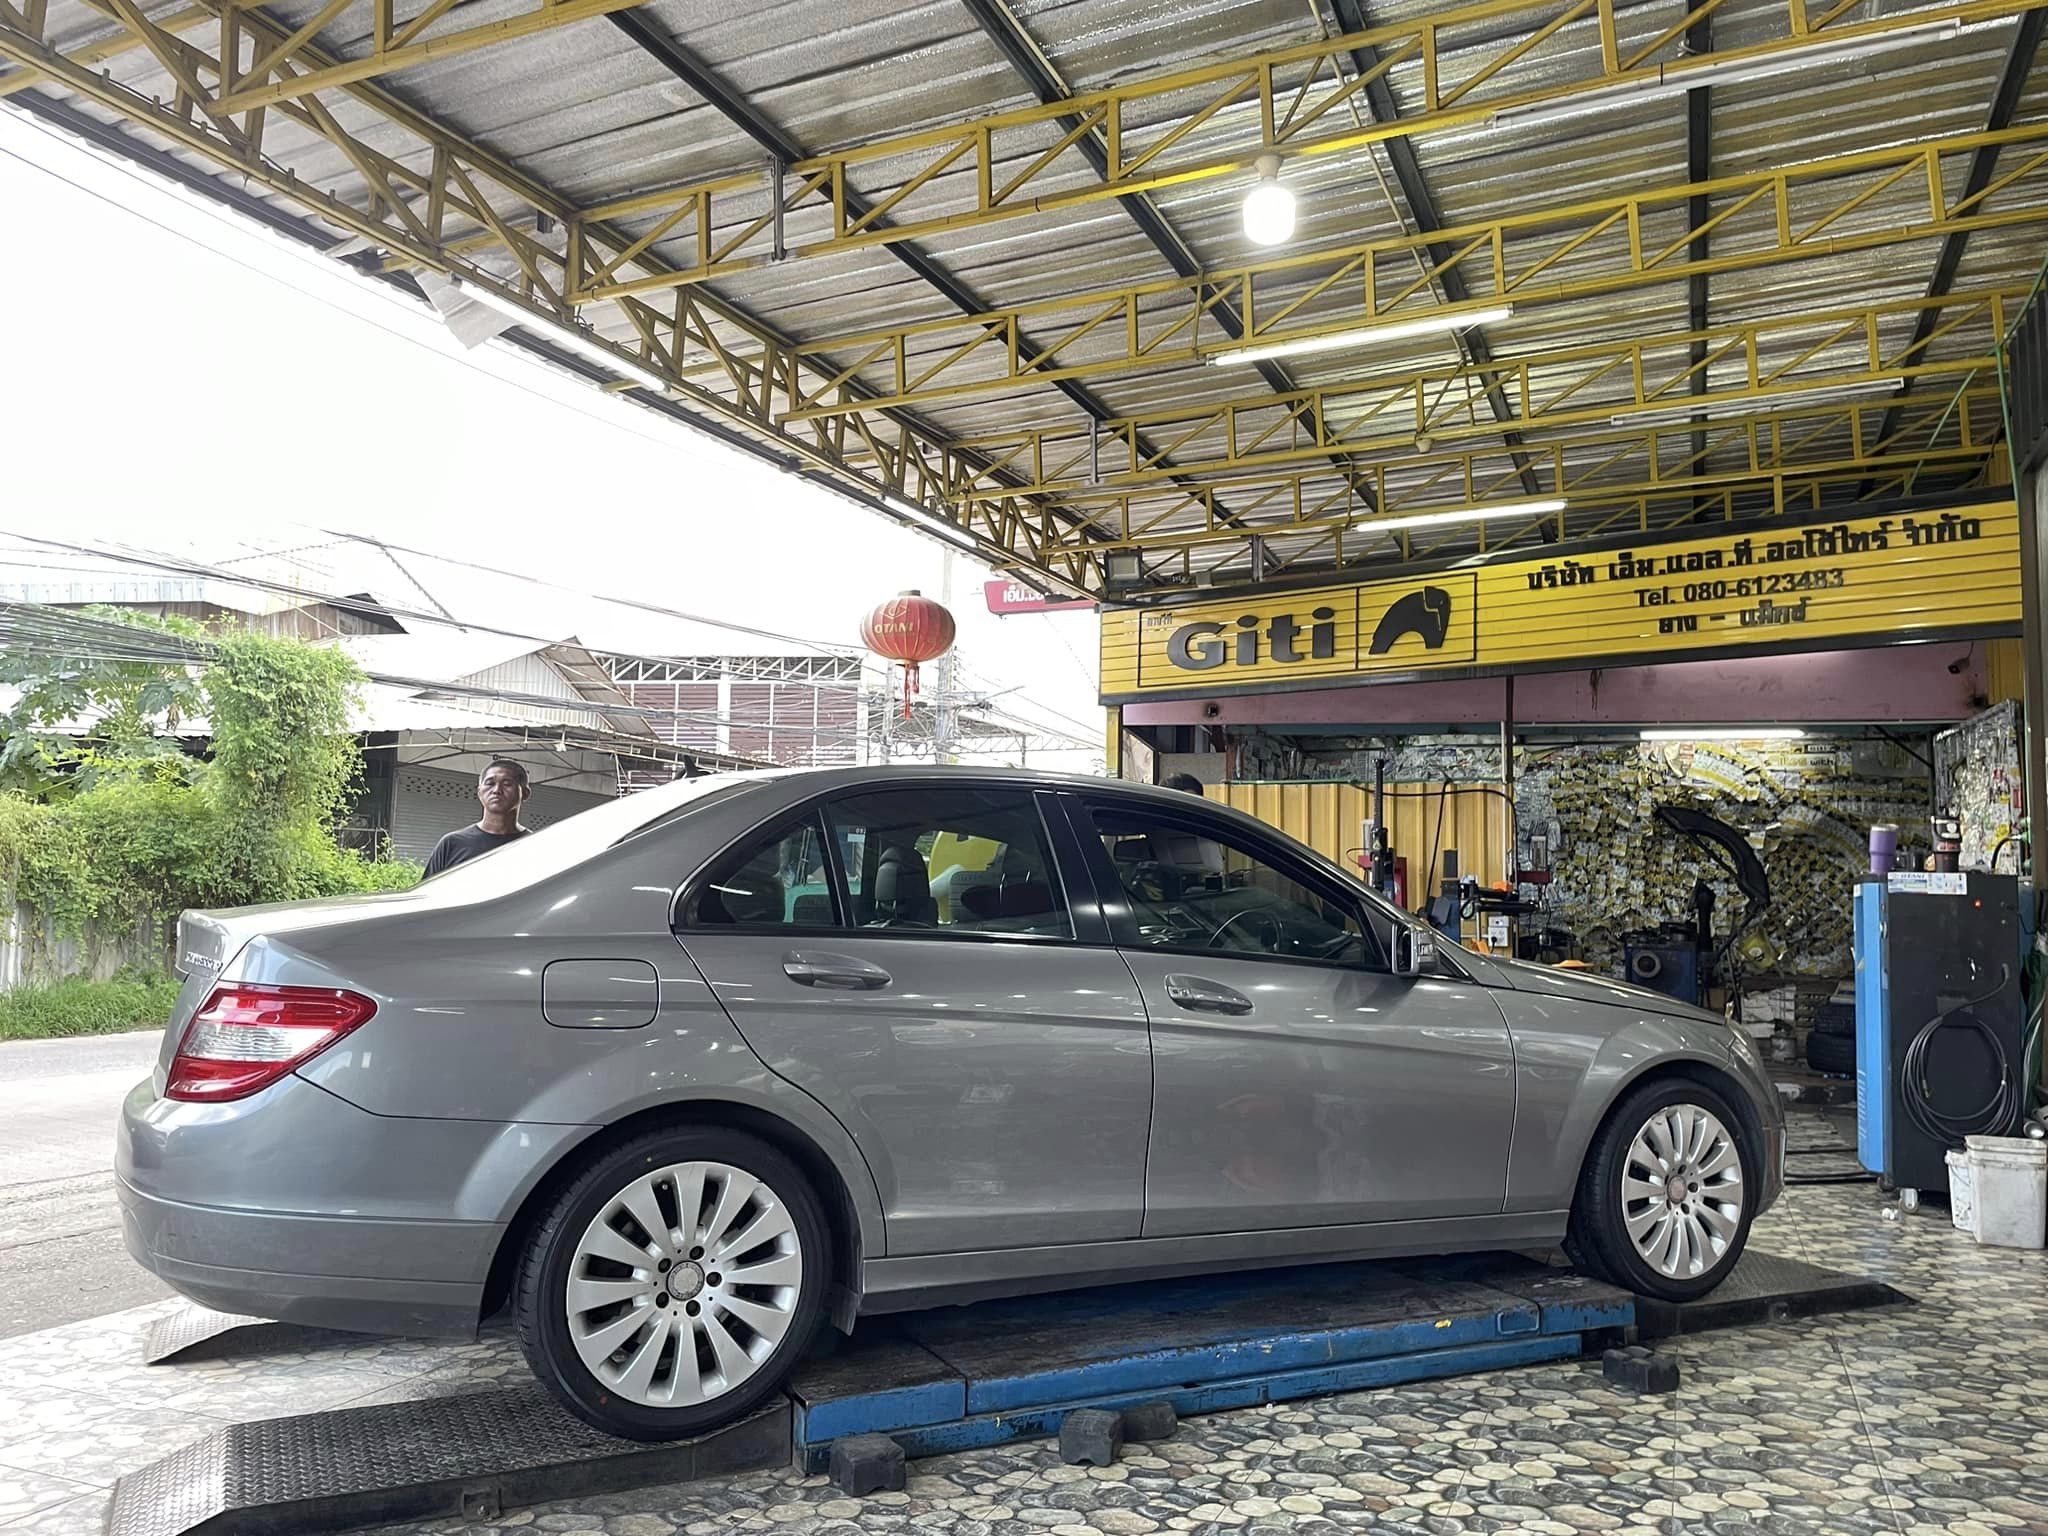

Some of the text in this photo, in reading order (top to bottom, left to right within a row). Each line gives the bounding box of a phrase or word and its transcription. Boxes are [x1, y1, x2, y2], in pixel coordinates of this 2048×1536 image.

[1527, 560, 1595, 590] บริษัท
[1902, 513, 1981, 546] จำกัด
[1634, 568, 1844, 607] Tel. 080-6123483
[874, 622, 914, 634] OTANI
[1166, 606, 1335, 671] Giti
